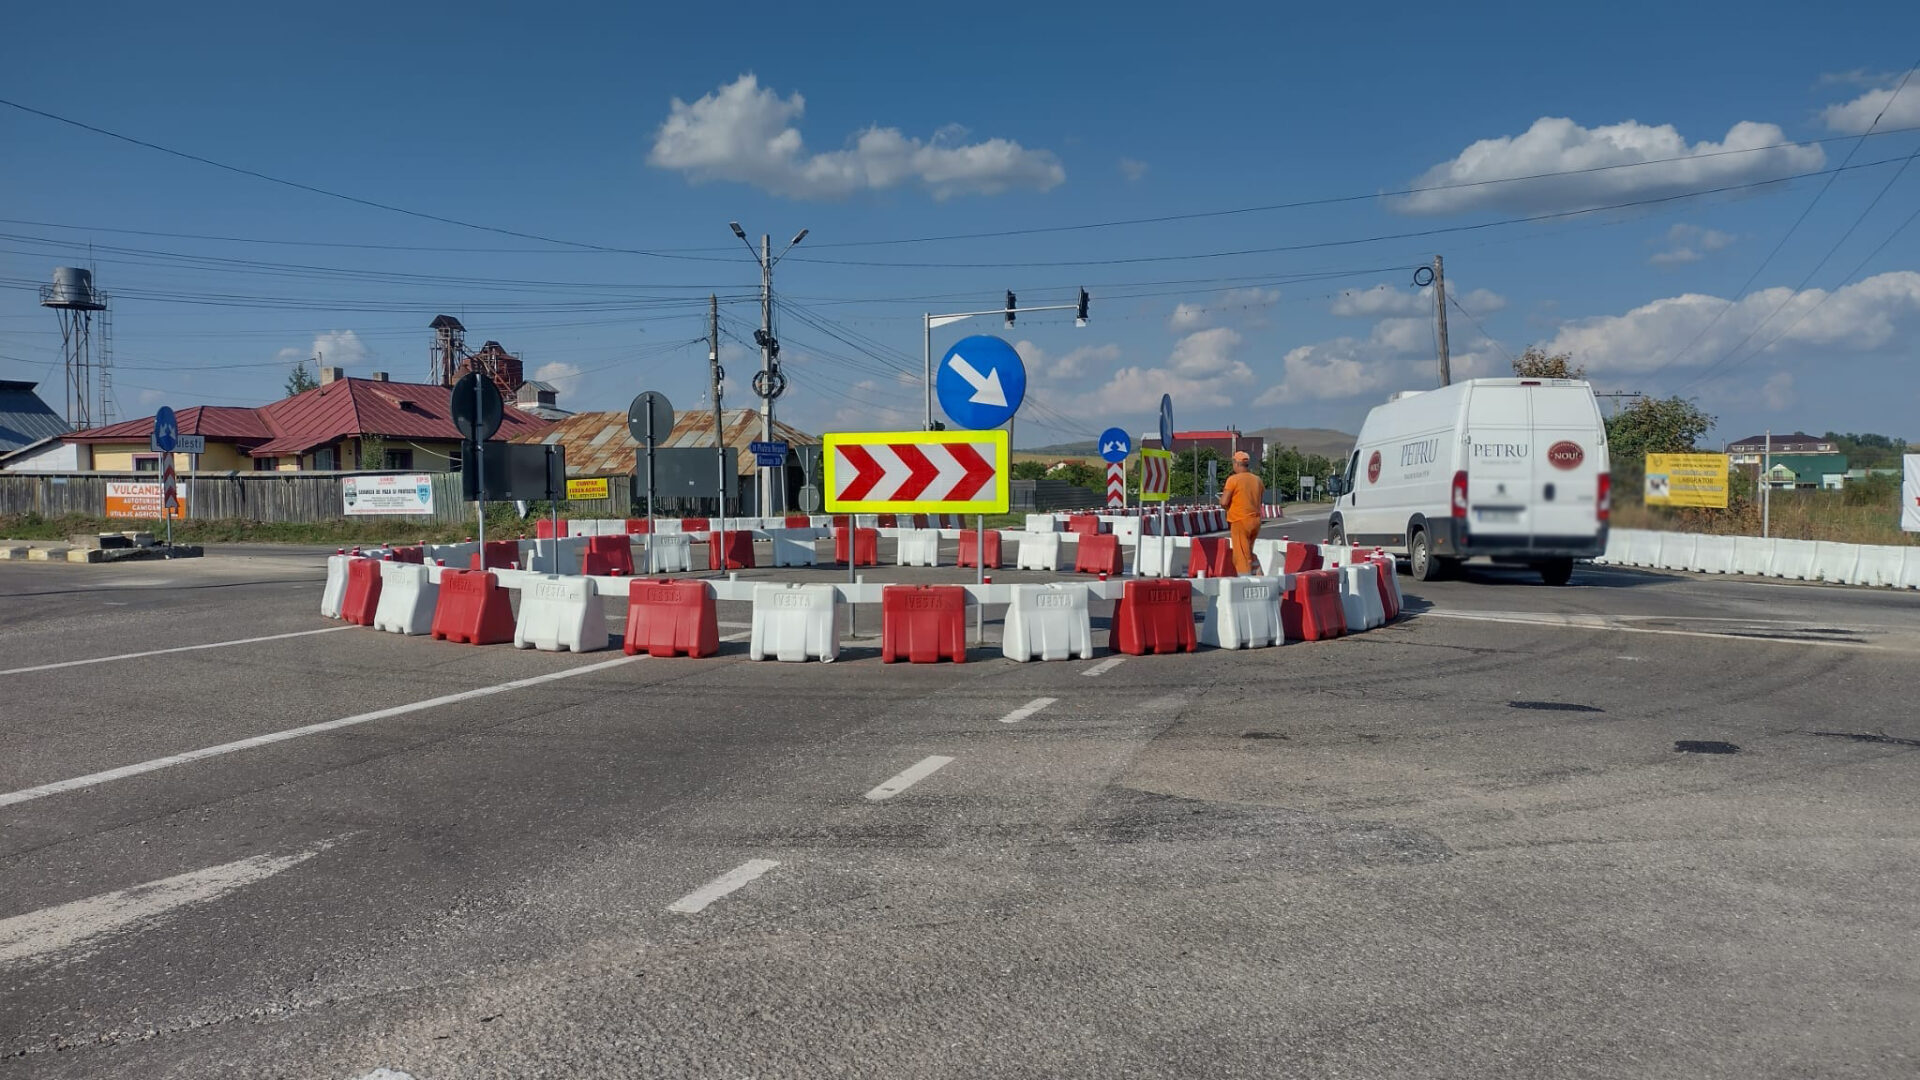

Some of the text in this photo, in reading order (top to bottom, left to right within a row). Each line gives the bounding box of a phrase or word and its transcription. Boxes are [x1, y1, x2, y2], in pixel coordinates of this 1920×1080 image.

[1400, 438, 1439, 467] PETRU
[1474, 443, 1528, 458] PETRU
[1554, 452, 1579, 460] NOU!
[112, 484, 178, 496] VULCANIZ
[651, 590, 681, 602] VESTA
[1150, 590, 1178, 602] VESTA
[1244, 586, 1269, 598] VESTA
[776, 594, 810, 608] VESTA
[908, 595, 942, 608] VESTA
[1038, 594, 1072, 607] VESTA
